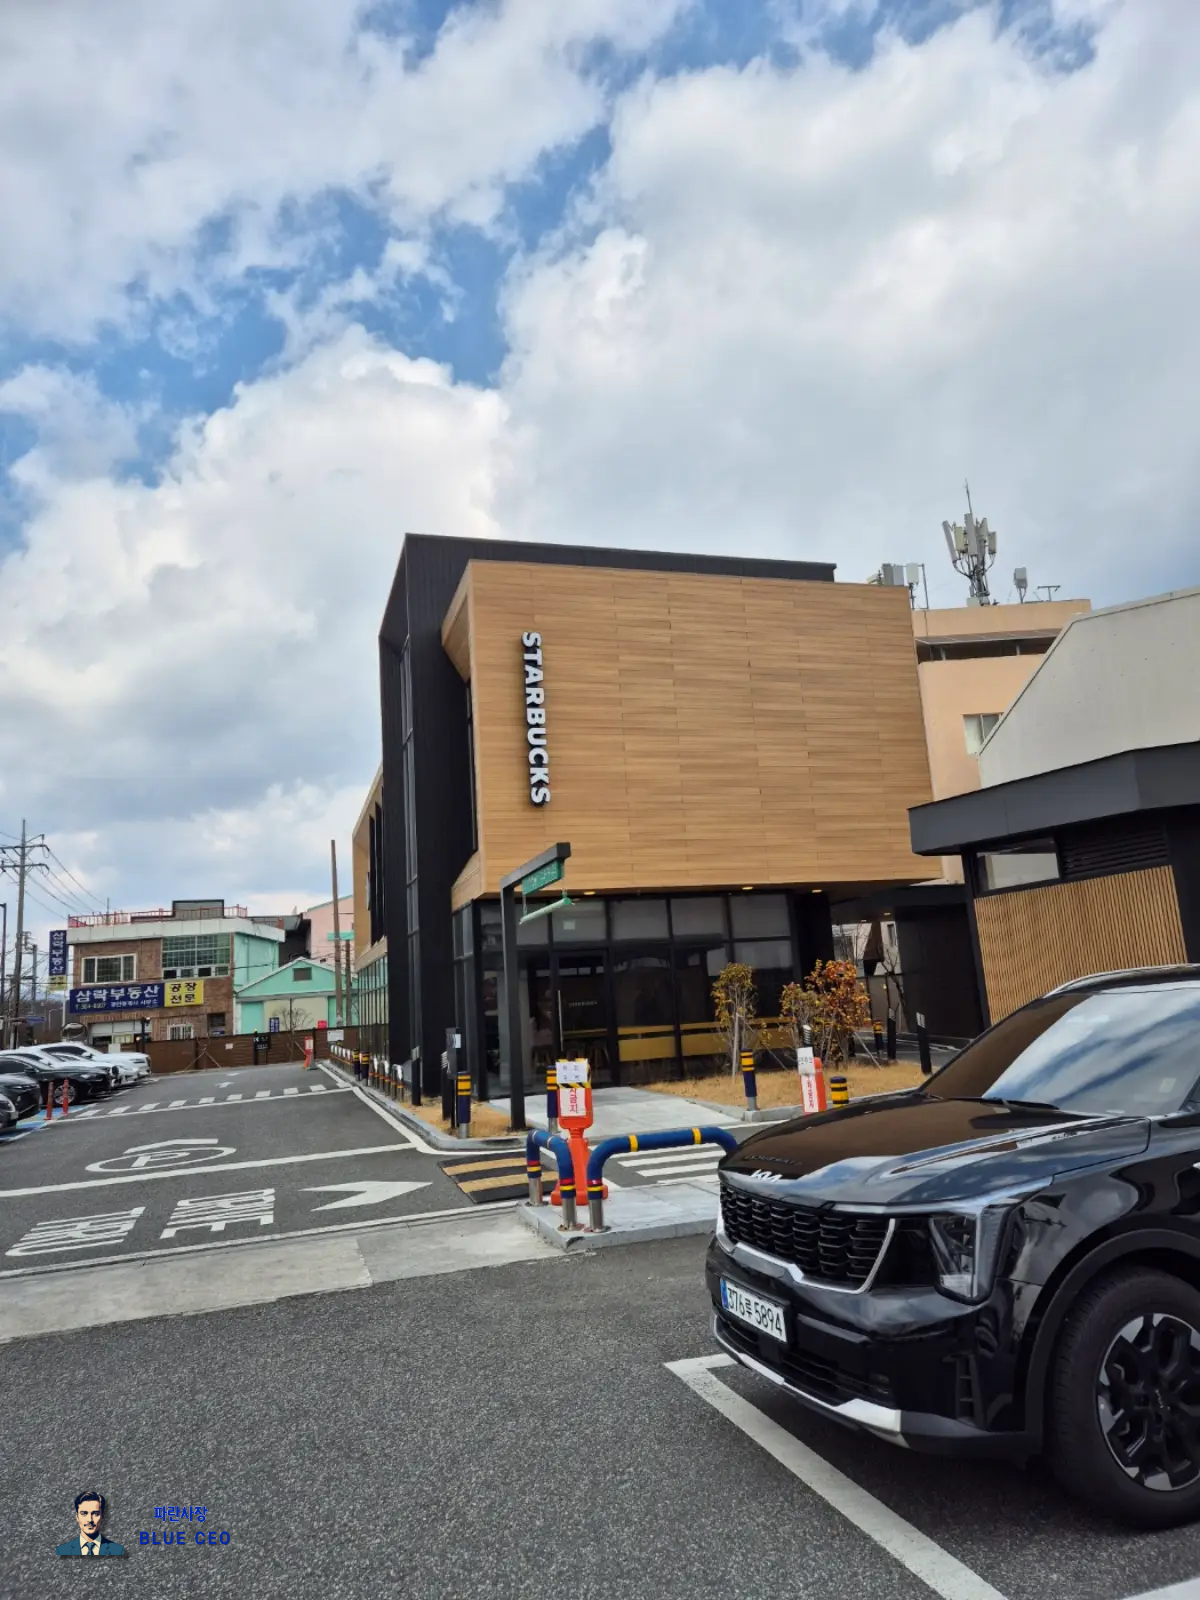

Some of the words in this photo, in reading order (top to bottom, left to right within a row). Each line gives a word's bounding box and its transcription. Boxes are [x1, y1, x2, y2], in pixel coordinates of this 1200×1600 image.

[522, 631, 551, 804] STARBUCKS
[75, 985, 160, 1003] 삼락부동산
[170, 981, 197, 992] 공장
[170, 993, 196, 1004] 전문
[160, 1188, 276, 1239] DRIVE
[4, 1206, 146, 1256] THRU
